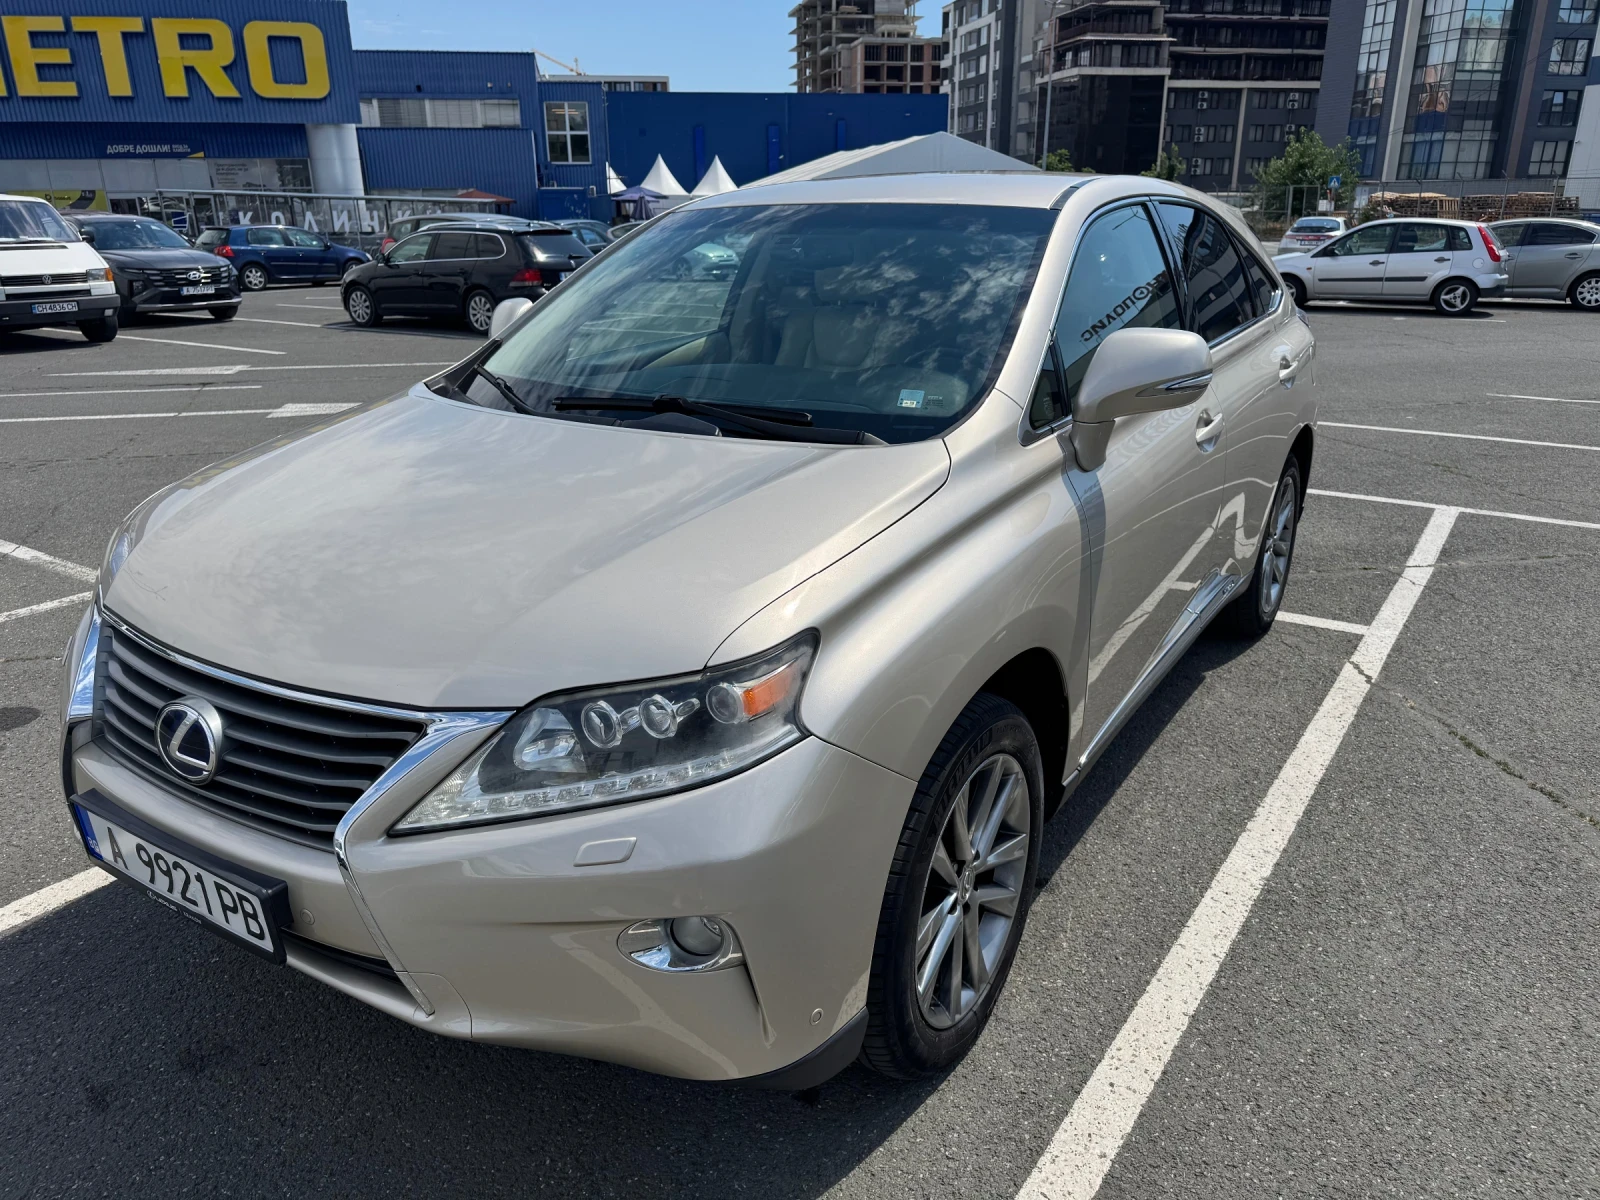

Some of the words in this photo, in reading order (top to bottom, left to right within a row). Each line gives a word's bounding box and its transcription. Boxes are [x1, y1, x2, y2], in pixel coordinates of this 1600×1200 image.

[0, 16, 331, 99] ETRO
[106, 145, 135, 154] ДОБРЕ
[136, 144, 171, 154] ДОШЛИ!
[107, 826, 130, 870] A
